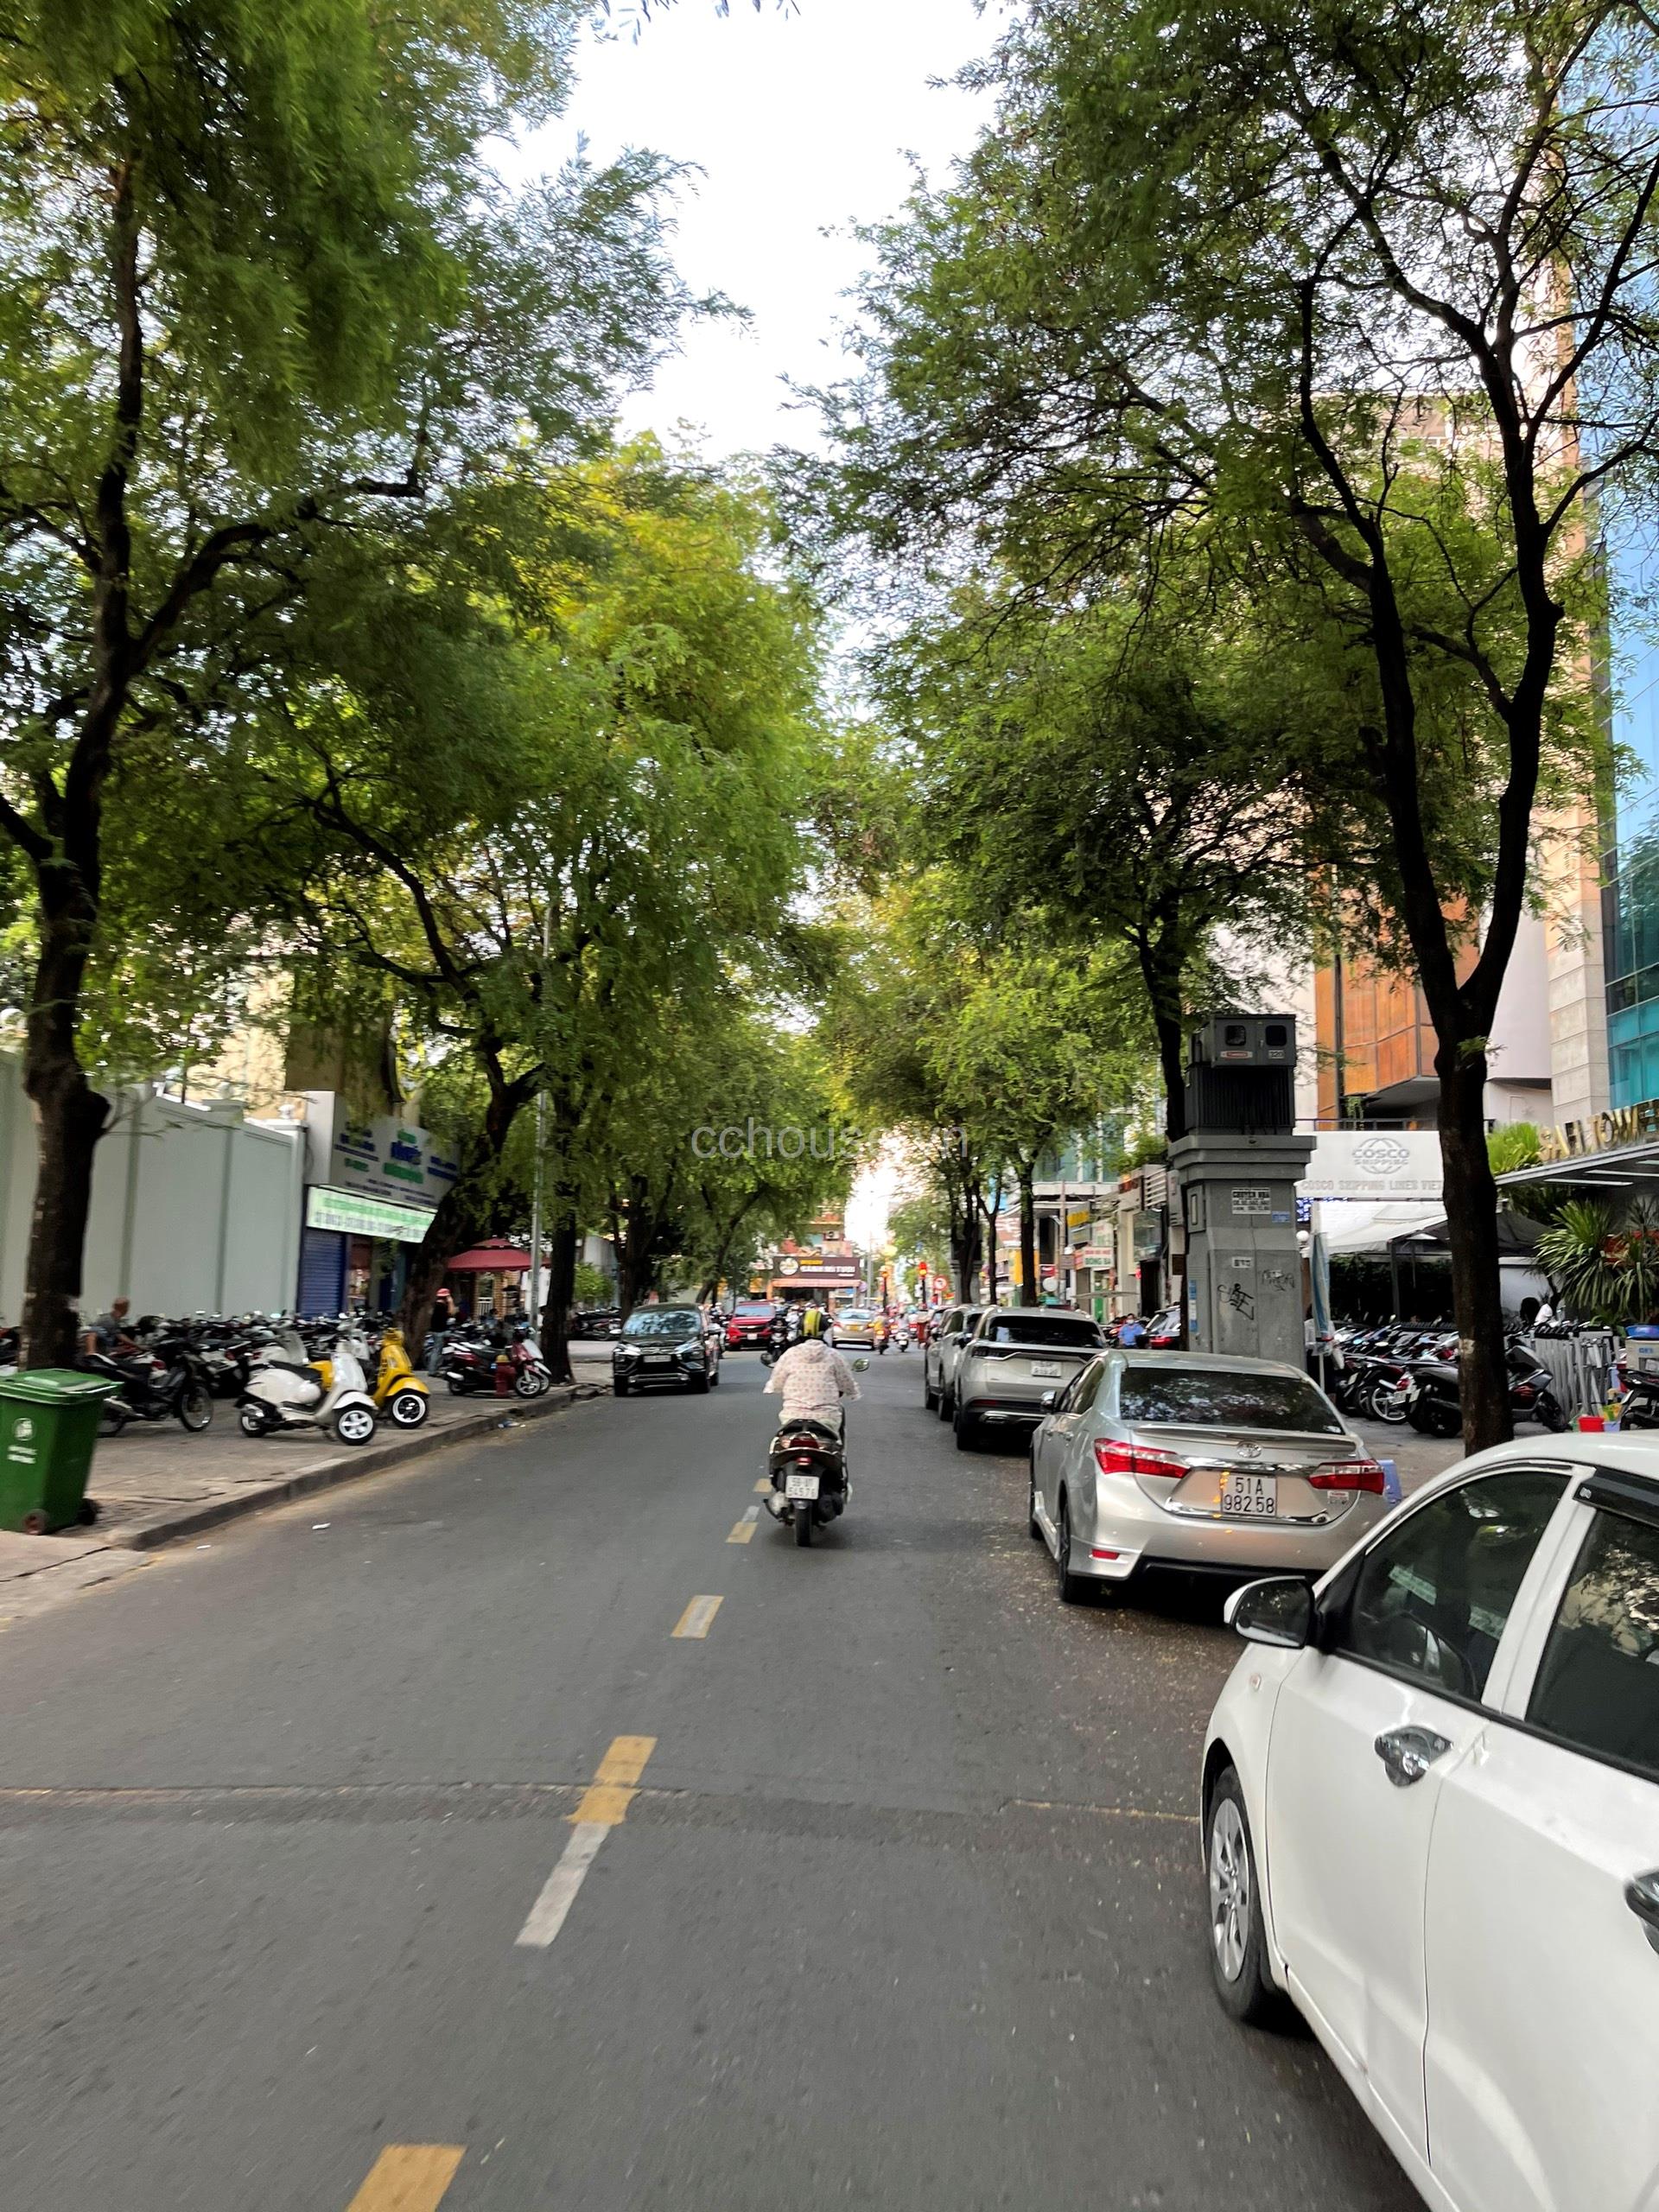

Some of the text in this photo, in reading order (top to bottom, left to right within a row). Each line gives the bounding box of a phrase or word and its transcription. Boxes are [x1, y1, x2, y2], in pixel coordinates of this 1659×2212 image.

[1586, 1099, 1659, 1150] TOWE
[1352, 1148, 1410, 1159] COSCO
[1300, 1180, 1334, 1191] COSCO
[1339, 1180, 1385, 1191] SHIPPING
[1389, 1180, 1418, 1191] LINES
[1235, 1477, 1263, 1495] 51A
